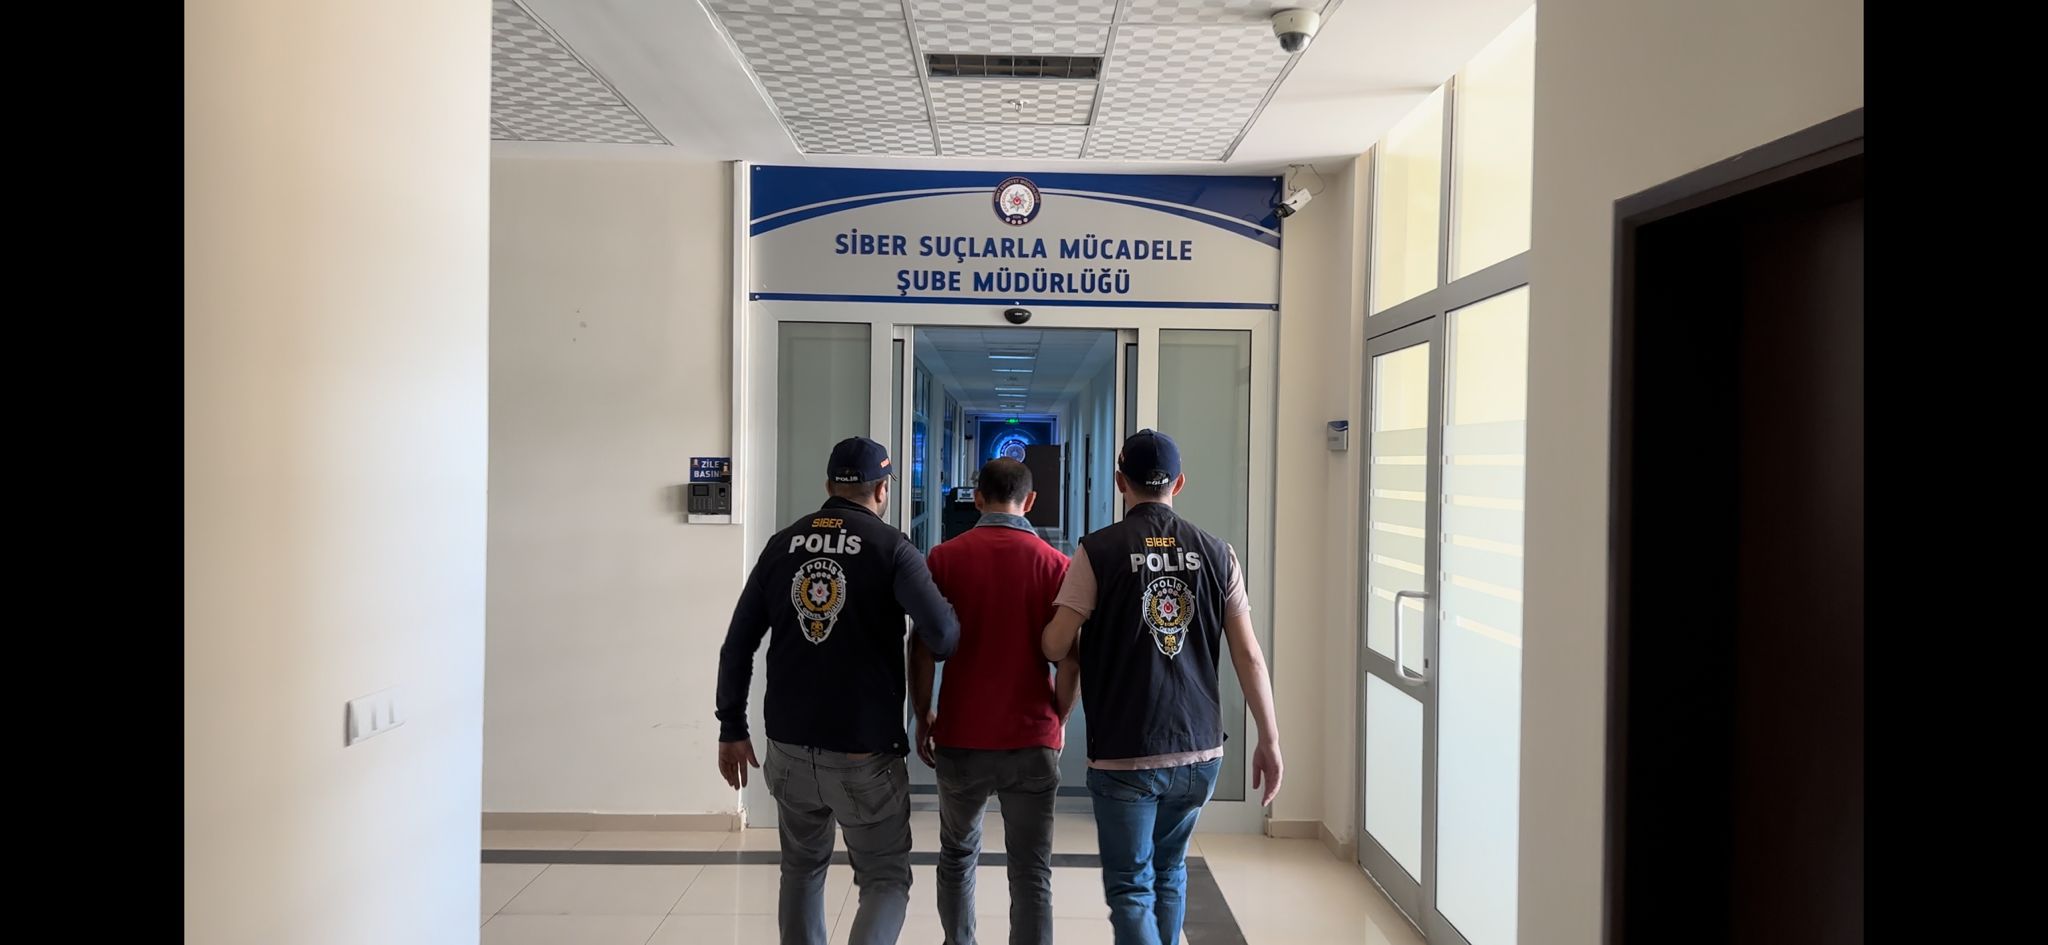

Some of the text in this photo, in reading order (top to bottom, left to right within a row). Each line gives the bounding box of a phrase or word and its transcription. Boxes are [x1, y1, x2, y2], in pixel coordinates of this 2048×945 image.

[835, 228, 1192, 264] SİBER SUÇLARLA MÜCADELE
[896, 267, 1130, 296] ŞUBE MÜDÜRLÜĞÜ
[788, 529, 862, 555] POLİS
[1130, 547, 1201, 573] POLİS
